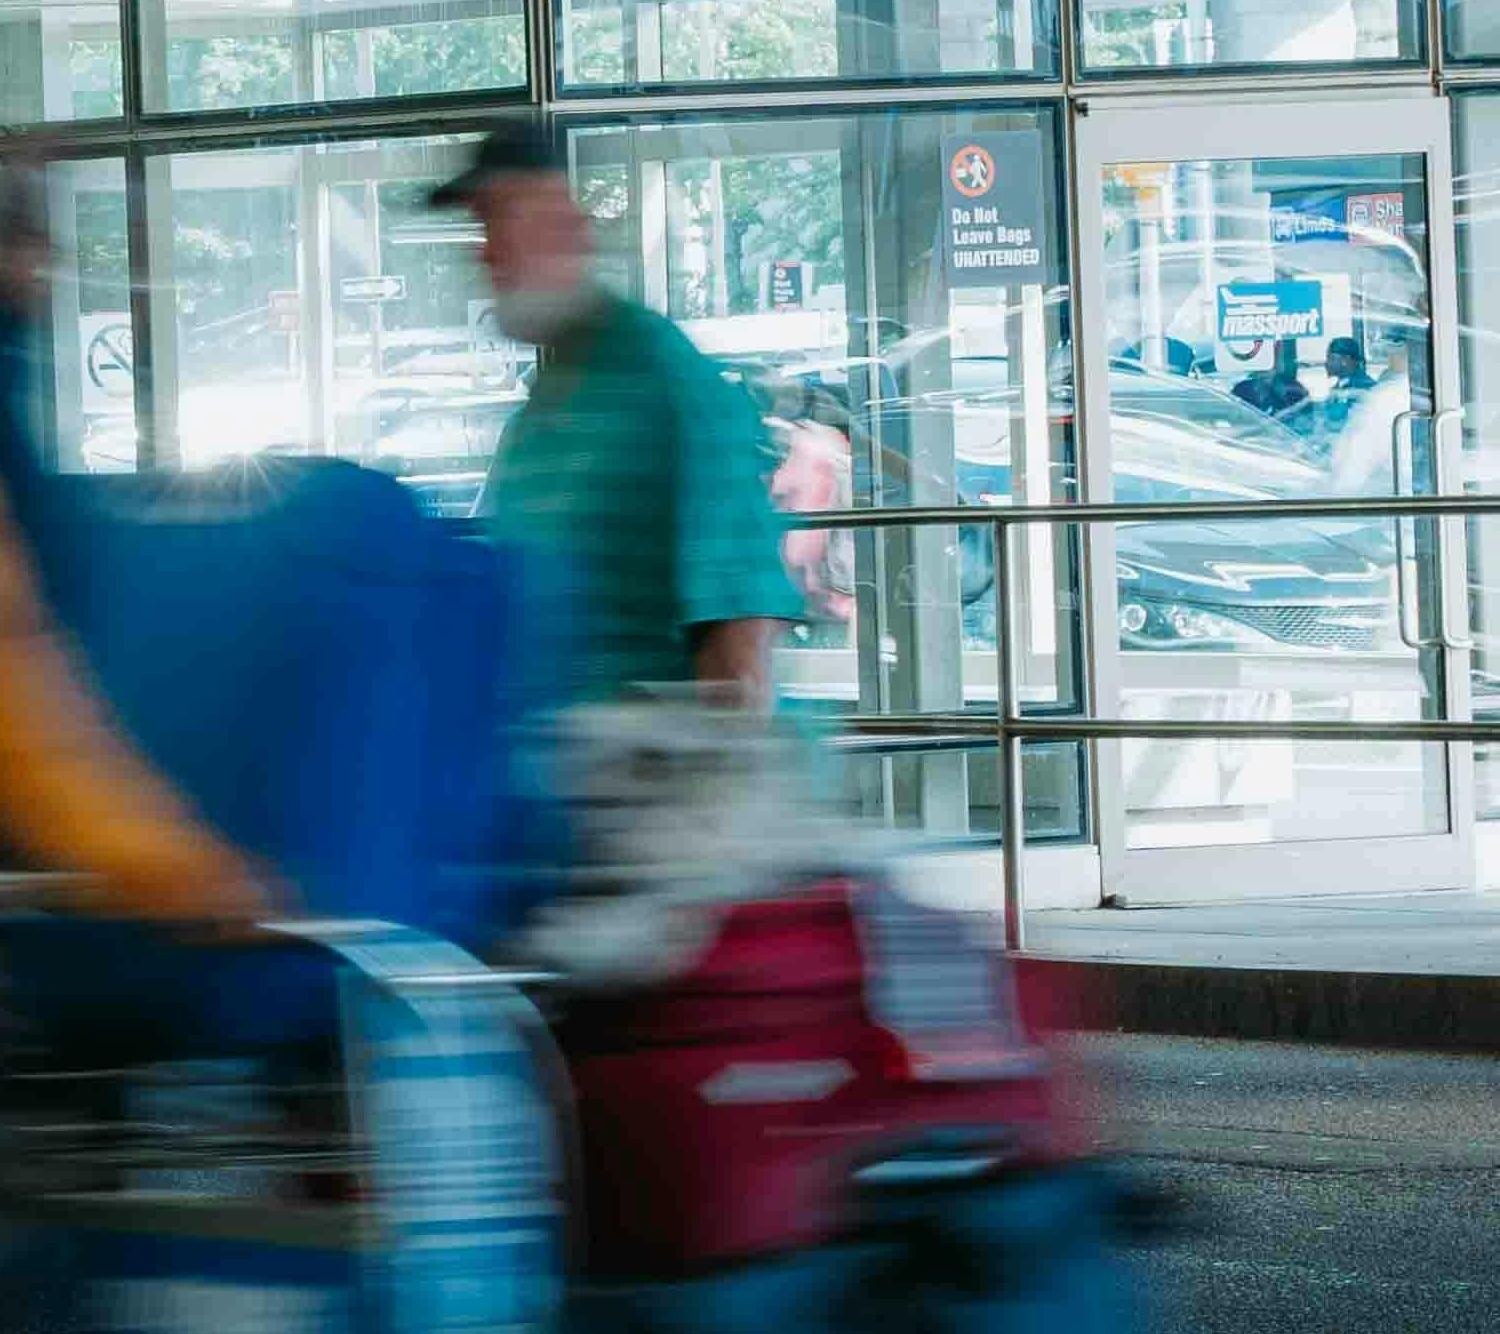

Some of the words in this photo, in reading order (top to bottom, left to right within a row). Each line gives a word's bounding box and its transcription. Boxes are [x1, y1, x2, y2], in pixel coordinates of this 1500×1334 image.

[952, 208, 970, 224] Do
[974, 207, 999, 223] Not
[953, 228, 993, 244] Leave
[997, 226, 1031, 245] Bags
[953, 248, 1040, 267] UNATTENDED
